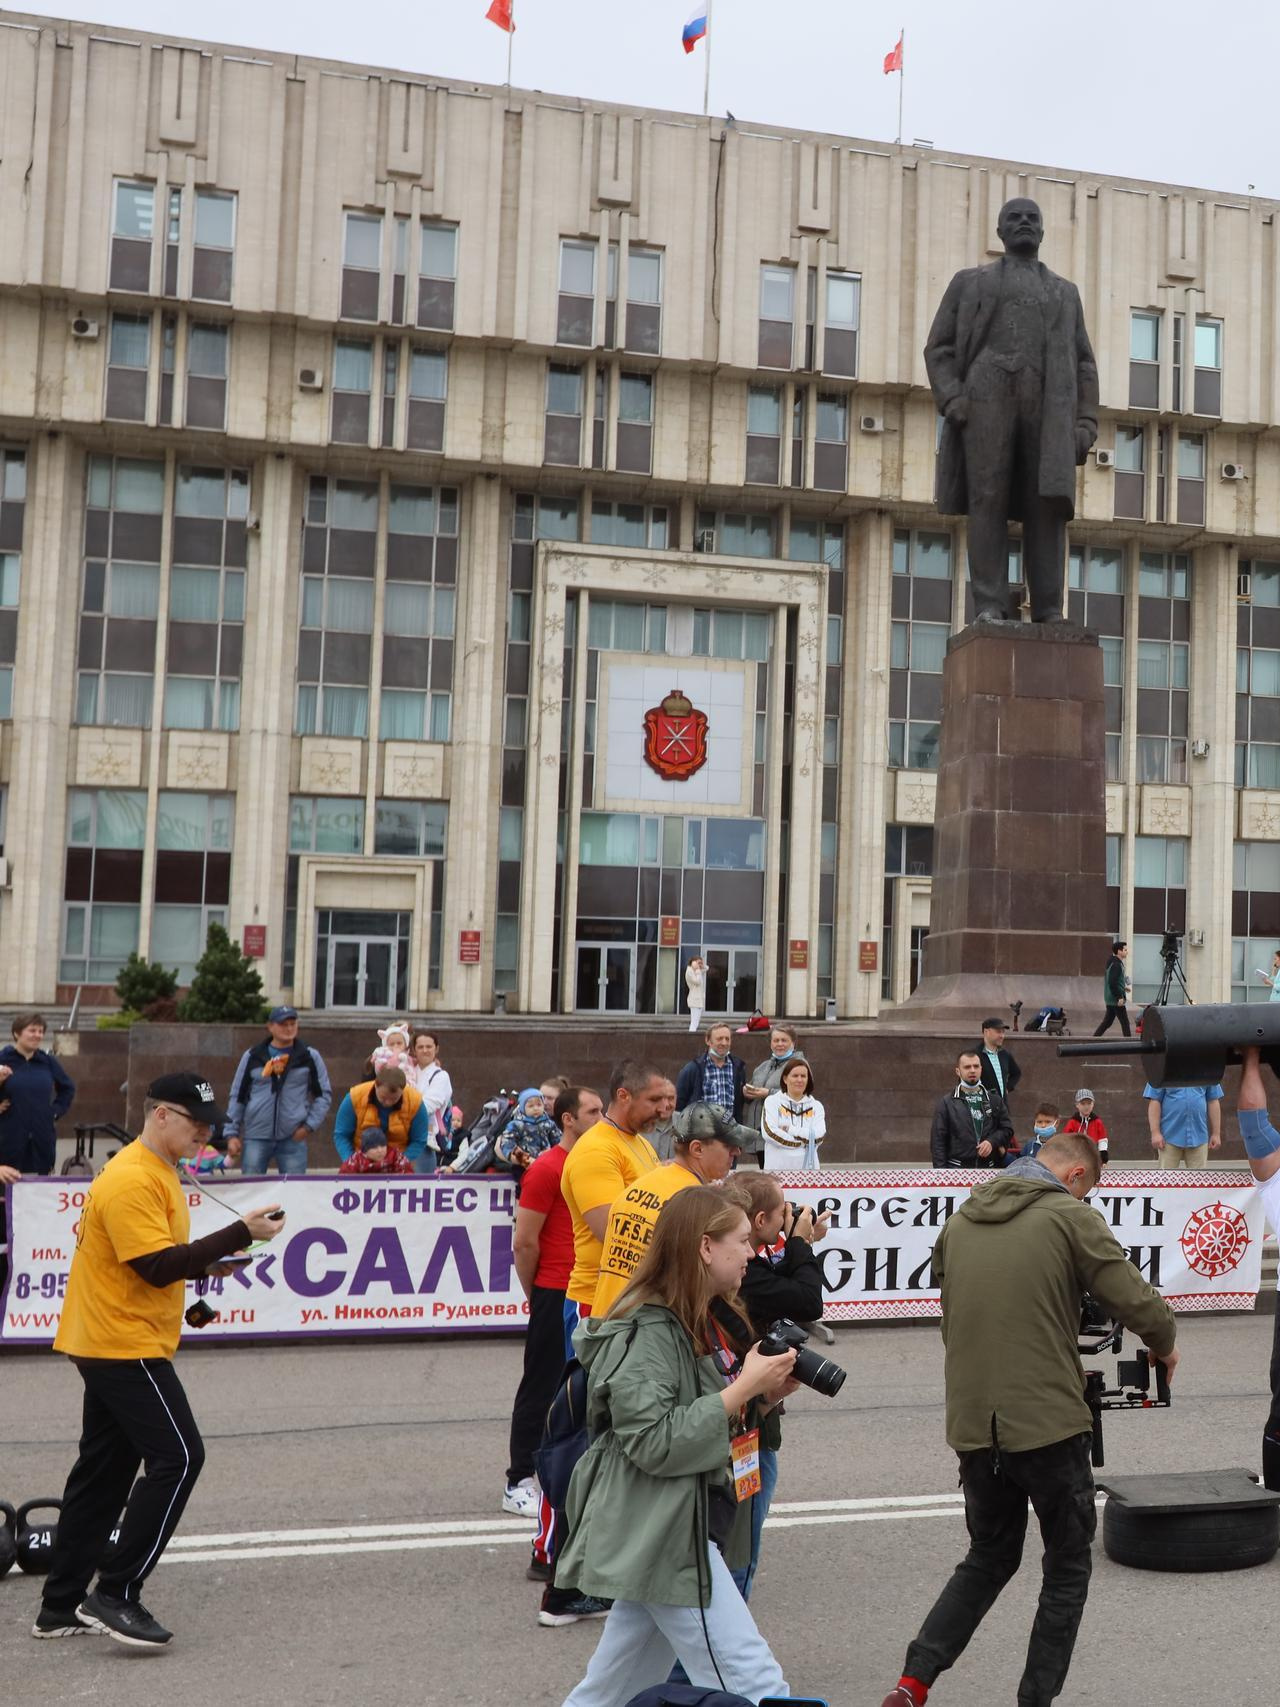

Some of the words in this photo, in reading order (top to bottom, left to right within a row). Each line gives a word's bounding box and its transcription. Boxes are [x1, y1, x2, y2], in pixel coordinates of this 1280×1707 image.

[332, 1187, 478, 1215] ФИТНЕС
[489, 1188, 514, 1217] Ц
[817, 1196, 956, 1229] ВРЕМ
[31, 1247, 67, 1260] им.
[301, 1308, 328, 1324] ул.
[334, 1304, 424, 1320] Николая
[432, 1302, 518, 1319] Руднева
[29, 1531, 51, 1549] 24
